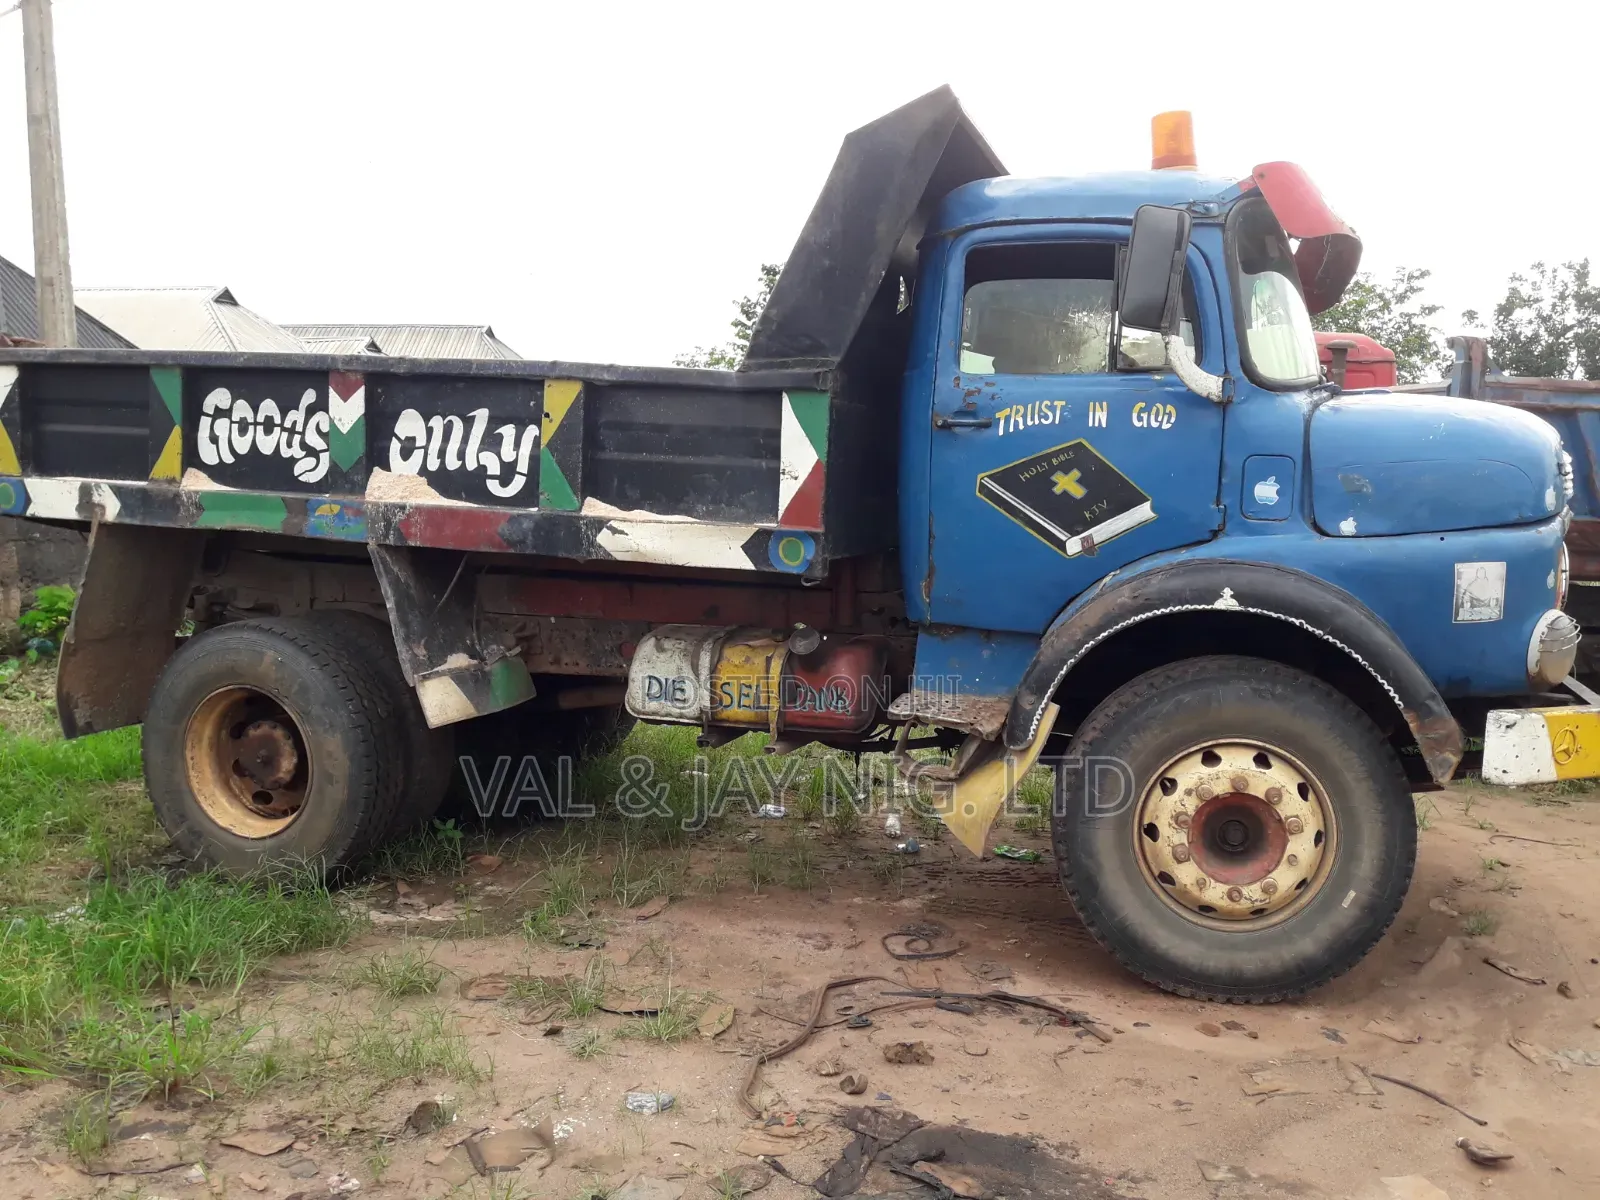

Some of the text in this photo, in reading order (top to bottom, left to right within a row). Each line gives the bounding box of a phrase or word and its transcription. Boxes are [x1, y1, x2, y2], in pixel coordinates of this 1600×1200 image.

[197, 387, 330, 483] Goods
[995, 400, 1177, 436] TRUST IN GOD
[1018, 450, 1076, 482] HOLY BIBLE
[1083, 499, 1108, 522] KJV
[647, 675, 687, 703] DIE
[718, 681, 771, 711] SEL
